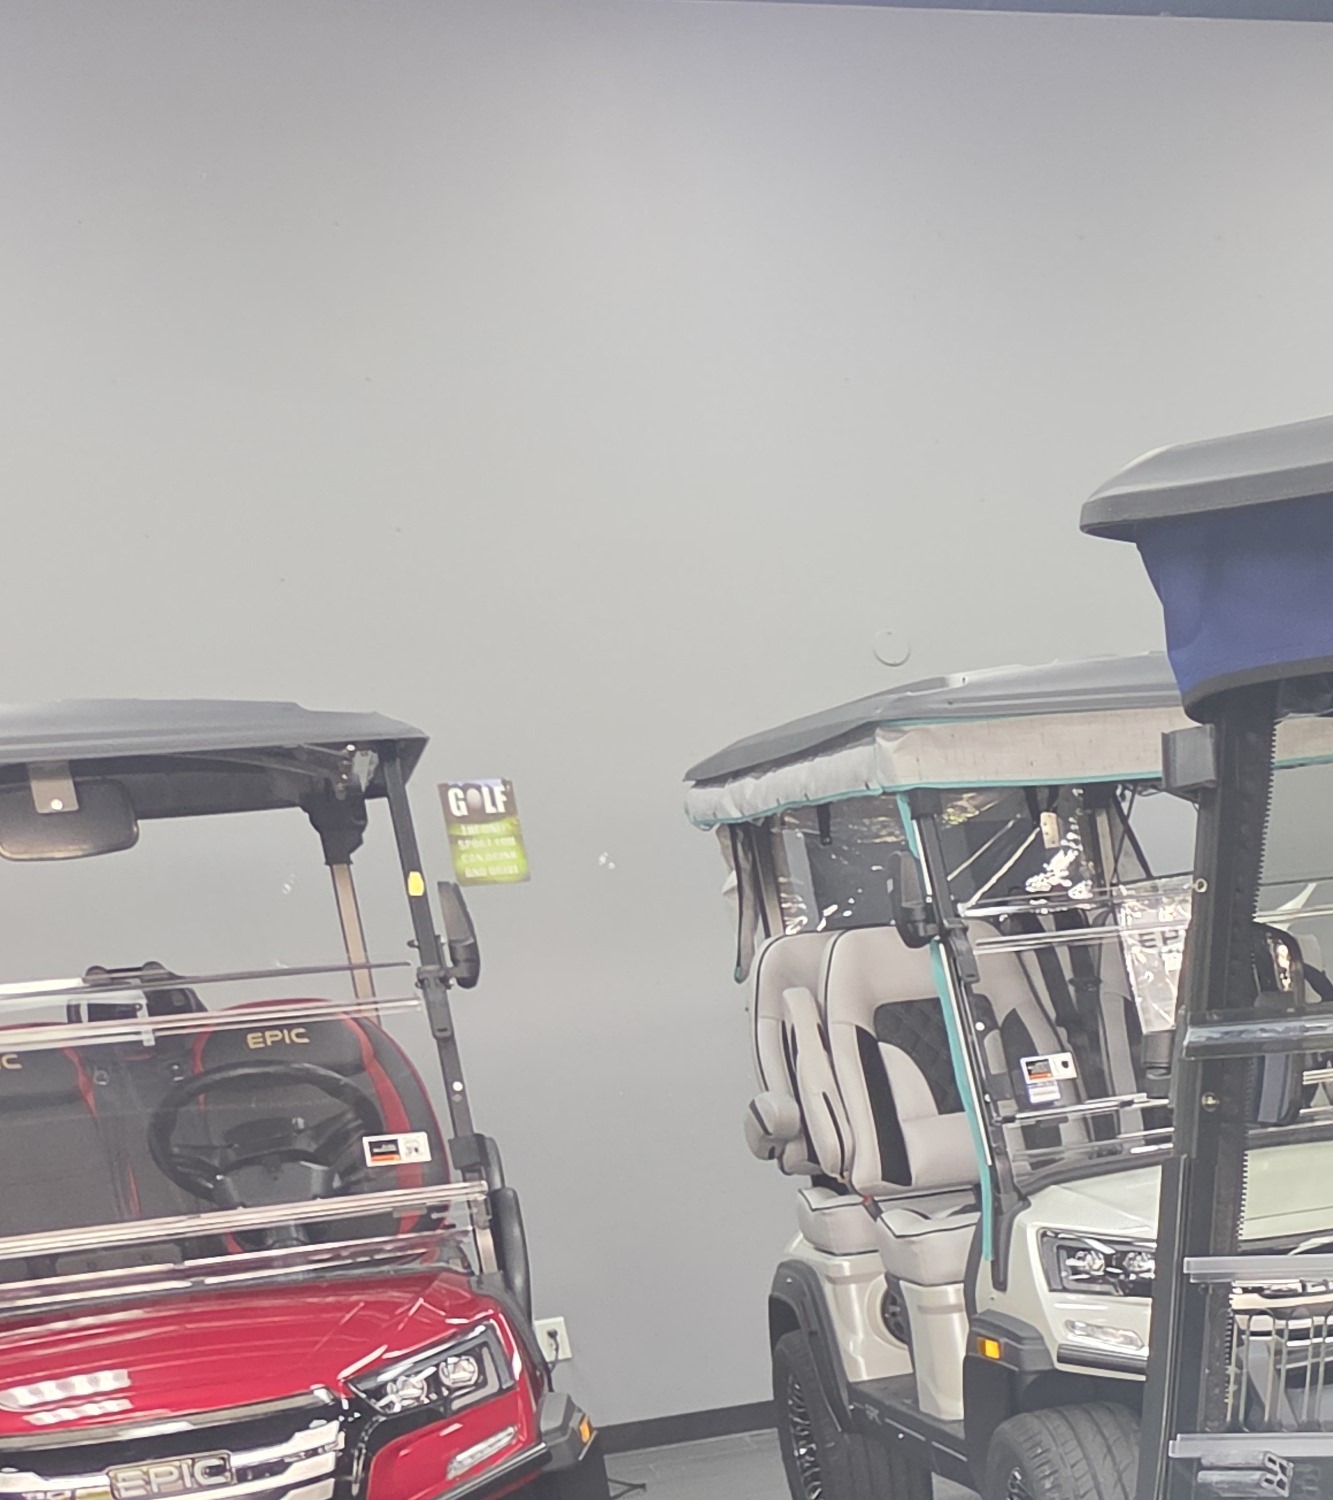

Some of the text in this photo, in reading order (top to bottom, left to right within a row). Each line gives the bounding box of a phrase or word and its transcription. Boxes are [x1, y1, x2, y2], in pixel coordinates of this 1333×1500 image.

[447, 785, 508, 817] GOLF
[246, 1027, 311, 1050] EPIC
[116, 1457, 231, 1498] EPIC
